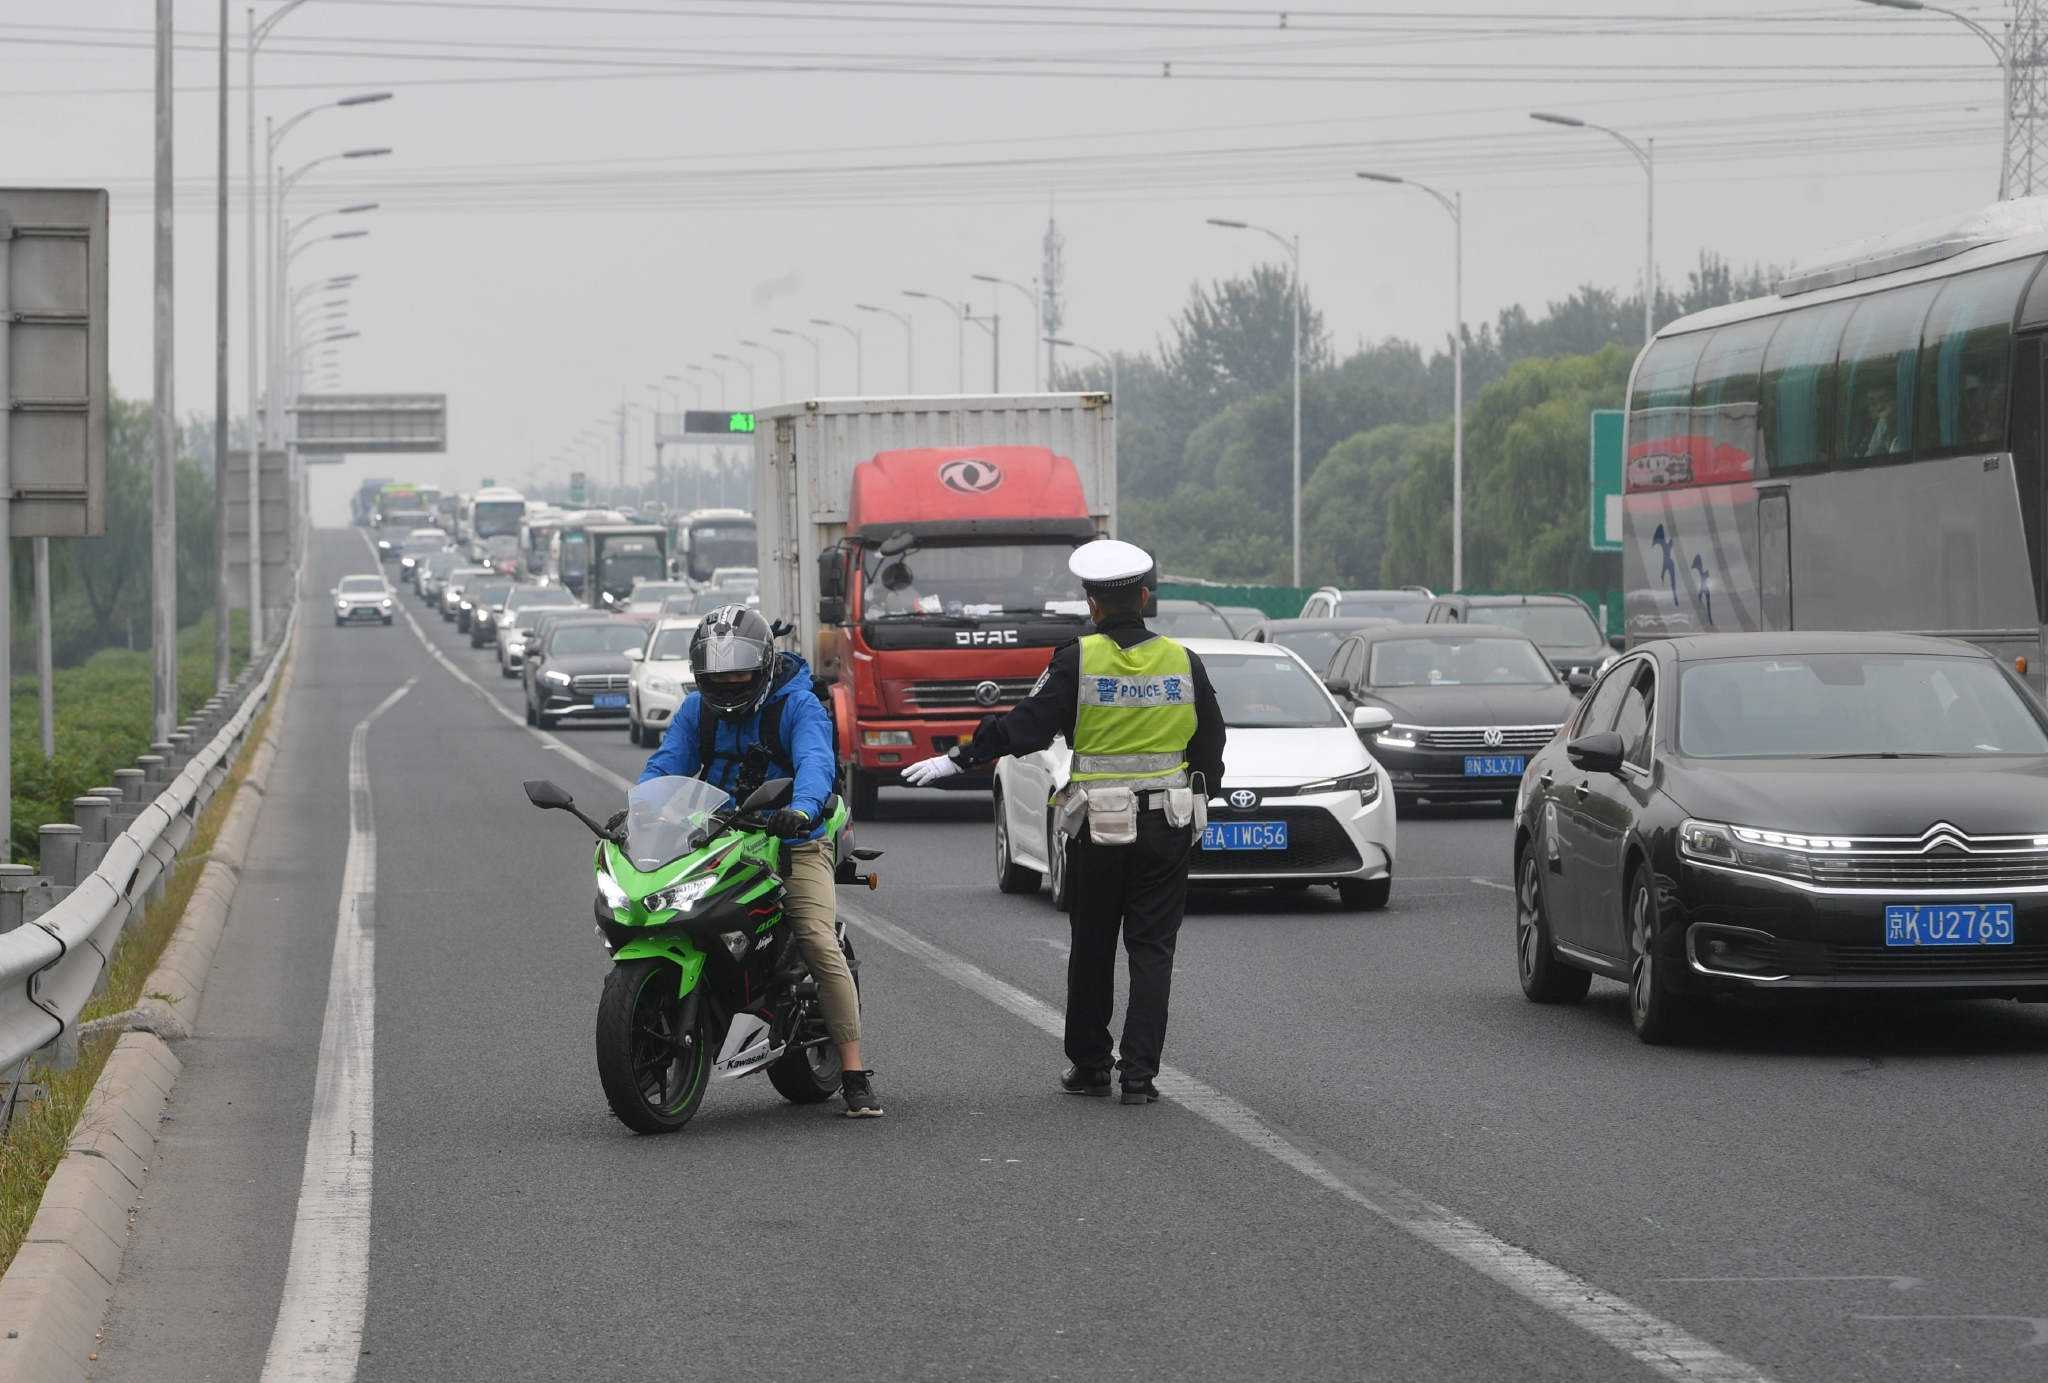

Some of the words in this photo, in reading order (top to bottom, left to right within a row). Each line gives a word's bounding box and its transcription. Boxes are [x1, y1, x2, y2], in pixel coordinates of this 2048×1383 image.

[1097, 678, 1118, 702] 警
[1121, 685, 1161, 698] POLICE
[1163, 677, 1182, 701] 察
[727, 1050, 769, 1070] Kawasaki
